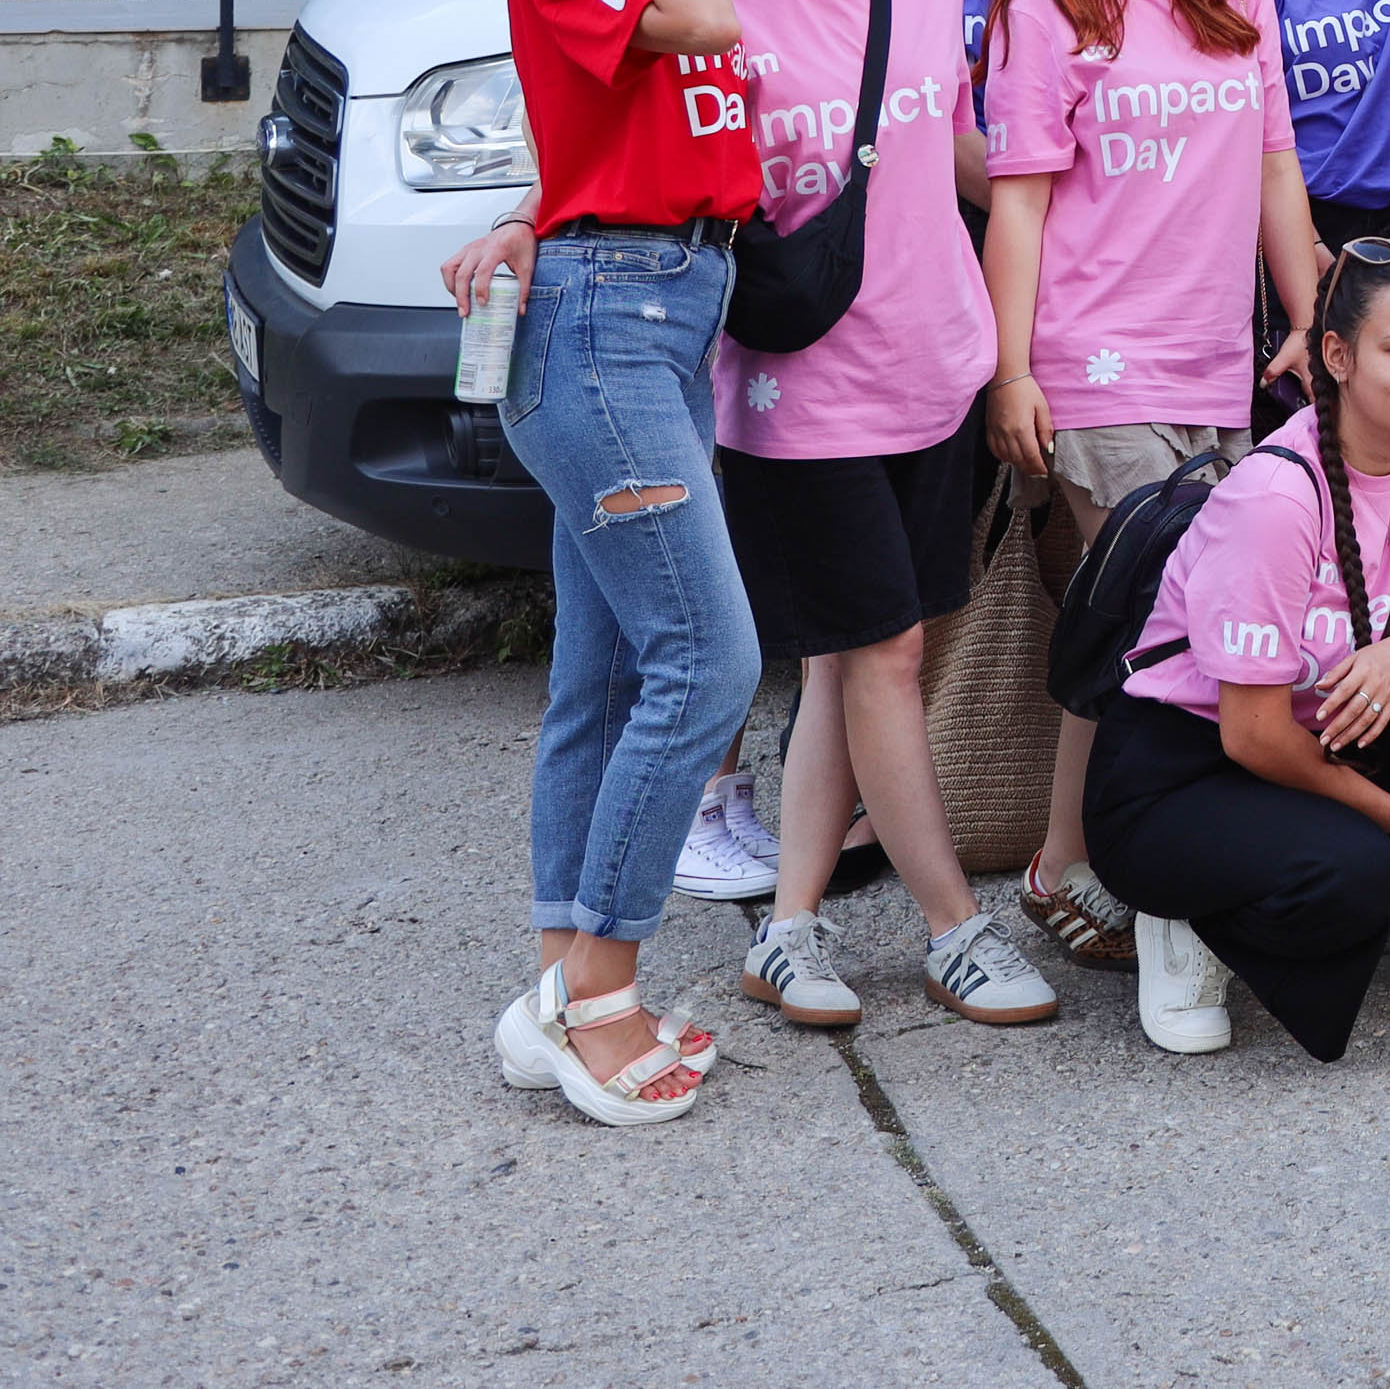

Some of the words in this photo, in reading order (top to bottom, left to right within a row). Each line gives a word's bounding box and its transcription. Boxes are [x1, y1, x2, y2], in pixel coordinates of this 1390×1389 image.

[683, 84, 747, 138] Da
[1094, 70, 1261, 128] Impact
[1099, 131, 1188, 183] Day
[1223, 620, 1280, 659] um
